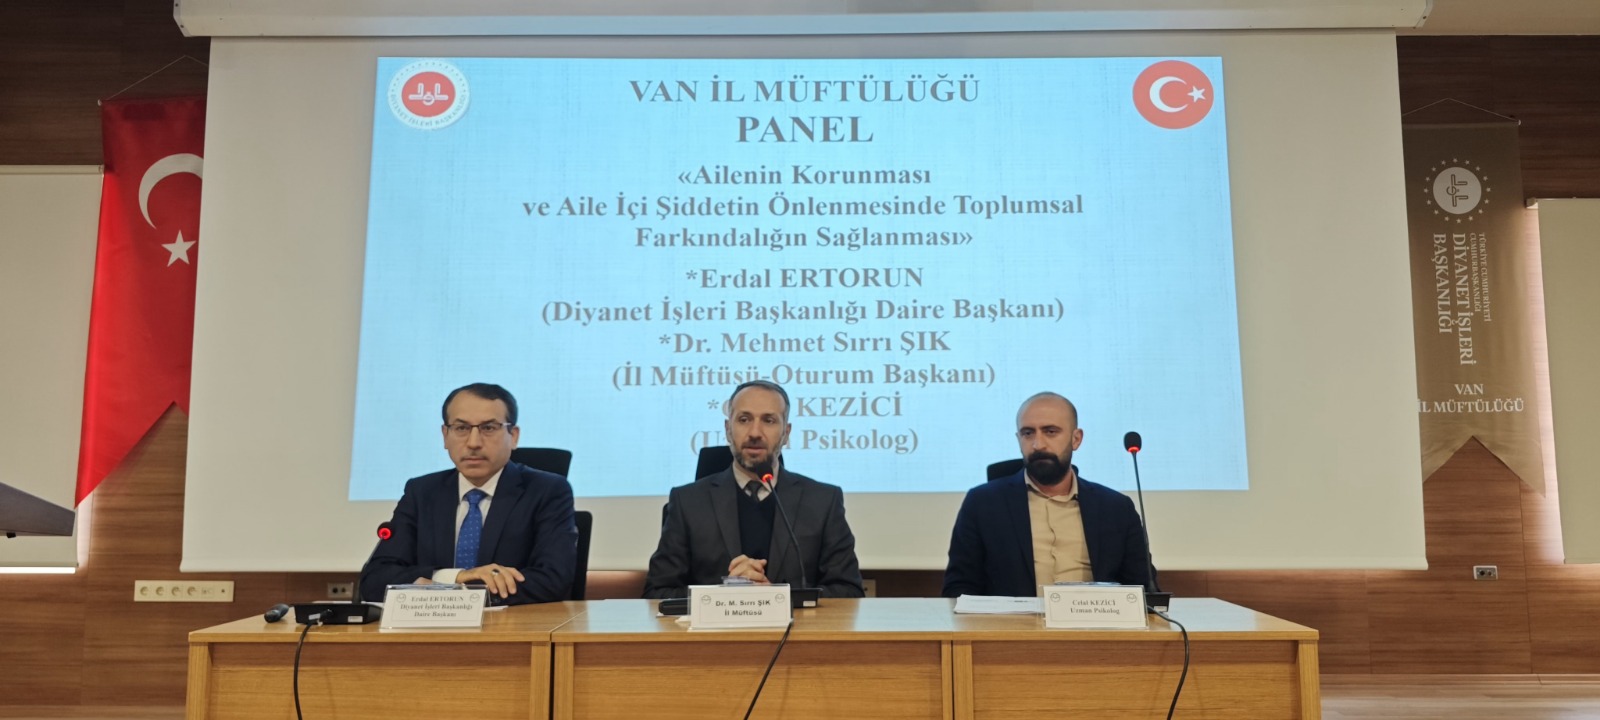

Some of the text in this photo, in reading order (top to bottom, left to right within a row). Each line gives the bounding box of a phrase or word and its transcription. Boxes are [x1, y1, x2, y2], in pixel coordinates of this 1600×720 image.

[629, 74, 979, 102] VAN İL MÜFTÜLÜĞÜ
[737, 116, 874, 143] PANEL
[678, 165, 931, 185] «Ailenin Korunması
[523, 192, 1084, 221] ve Aile İçi Şiddetin Önlenmesinde Toplumsal
[635, 226, 973, 252] Farkındalığın Sağlanması»
[780, 267, 923, 288] ERTORUN
[1431, 233, 1452, 334] BAŞKANLIĞI
[542, 296, 1065, 326] (Diyanet İşleri Başkanlığı Daire Başkanı)
[1453, 233, 1477, 365] DİYANET İŞLERİ
[721, 332, 825, 353] Mehmet
[834, 331, 892, 352] Sırrı
[900, 331, 951, 356] ŞIK
[612, 361, 996, 391] (İl Müftüsü-Oturum Başkanı)
[1454, 384, 1484, 395] VAN
[796, 392, 903, 417] KEZİCİ
[1434, 398, 1524, 413] MÜFTÜLÜĞÜ
[801, 429, 919, 454] Psikolog)
[1094, 607, 1120, 615] Psikolog
